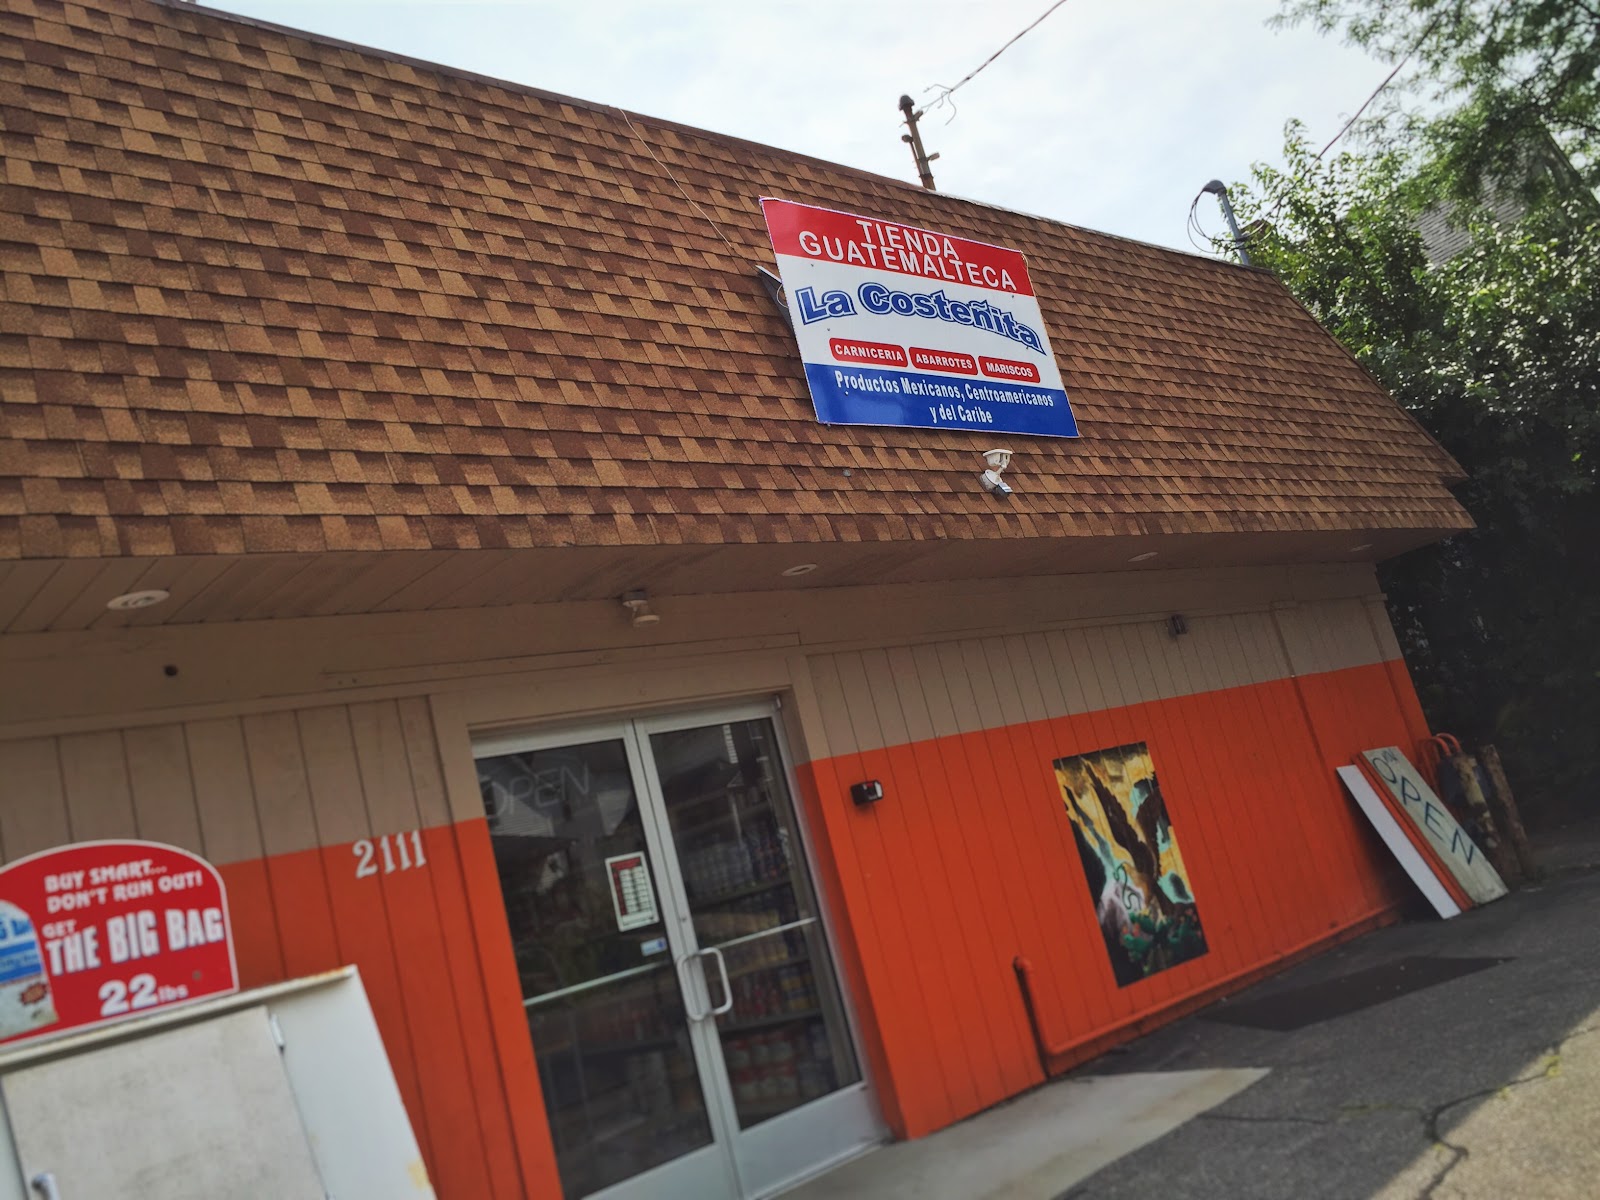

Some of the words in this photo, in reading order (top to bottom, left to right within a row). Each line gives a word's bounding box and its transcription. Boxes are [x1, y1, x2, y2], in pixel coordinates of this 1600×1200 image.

[856, 219, 960, 260] TIENDA
[798, 230, 1018, 291] GUATEMALTECA
[795, 286, 858, 325] La
[857, 282, 1047, 356] Costeñita
[834, 343, 904, 363] CARNICERIA
[915, 352, 973, 370] ABARROTES
[985, 361, 1034, 378] MARISCOS
[834, 370, 900, 393] Productos
[902, 377, 965, 402] Mexicanos,
[965, 383, 1054, 408] Centroamericanos
[929, 407, 937, 423] y
[938, 404, 957, 421] del
[957, 406, 994, 424] Caribe
[1372, 757, 1475, 866] OPEN
[352, 830, 427, 879] 2111
[44, 870, 85, 893] BUY
[89, 859, 168, 885] SMART...
[46, 887, 108, 914] DON'T
[112, 880, 154, 902] RUN
[157, 870, 203, 893] OUT!
[42, 919, 77, 939] GET
[45, 925, 101, 976] THE
[106, 909, 160, 964] BIG
[164, 907, 225, 952] BAG
[98, 972, 159, 1018] 22
[157, 984, 189, 1003] lbs
